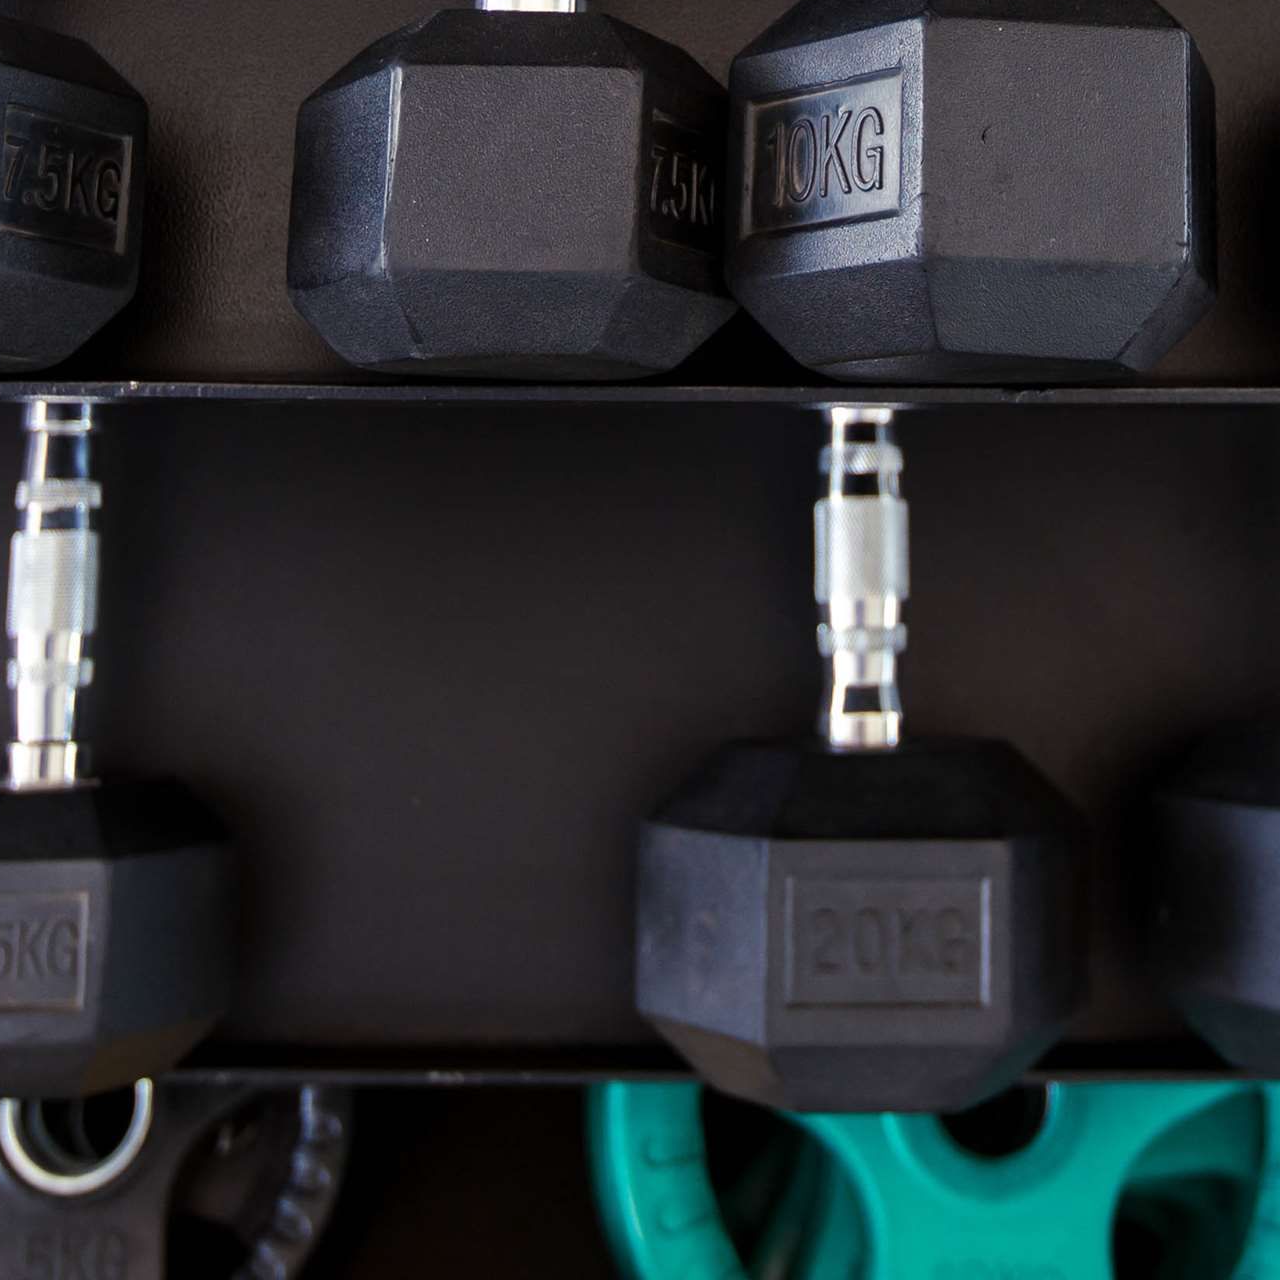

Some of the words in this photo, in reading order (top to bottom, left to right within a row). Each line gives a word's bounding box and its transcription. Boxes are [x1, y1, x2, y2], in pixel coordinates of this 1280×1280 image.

[3, 132, 122, 223] 7.5KG
[649, 144, 717, 226] 7.5K
[768, 105, 886, 209] 10KG
